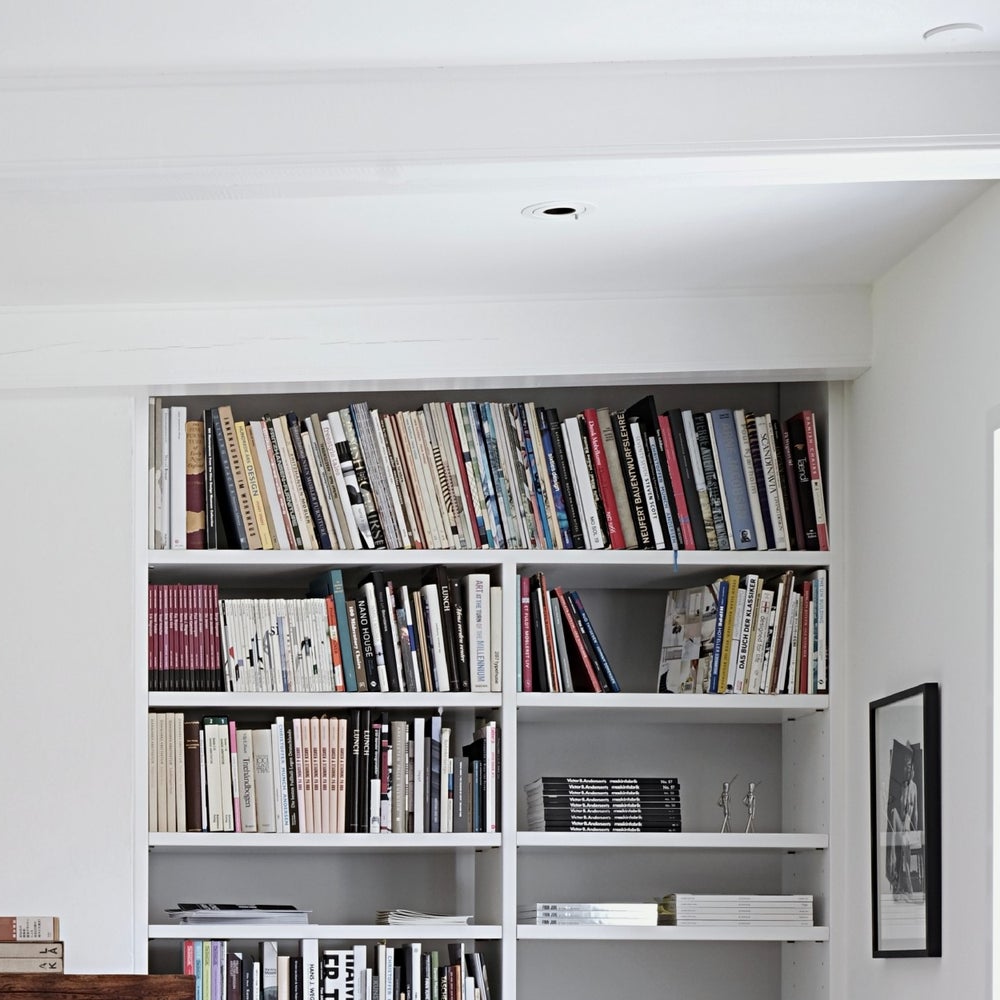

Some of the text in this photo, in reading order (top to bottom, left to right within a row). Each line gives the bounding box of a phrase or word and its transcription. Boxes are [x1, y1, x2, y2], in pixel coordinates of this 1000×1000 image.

[805, 416, 813, 443] DANISH
[547, 453, 560, 492] sixties design
[760, 433, 776, 494] SCANDINAVIA
[238, 480, 245, 488] IM
[247, 465, 259, 497] DESIGN
[616, 414, 650, 544] NEUFERT BAUENTWURFSLEHRE
[644, 478, 654, 500] STEVEN
[648, 501, 657, 519] SCOTT
[442, 586, 450, 612] LUNCH
[475, 580, 483, 593] ART
[358, 600, 373, 657] NANO HOUSE
[739, 578, 756, 669] DAS BUCH DER KLASSIKER
[756, 616, 766, 642] designed
[476, 640, 485, 682] MILLENNIUM
[756, 644, 764, 652] for
